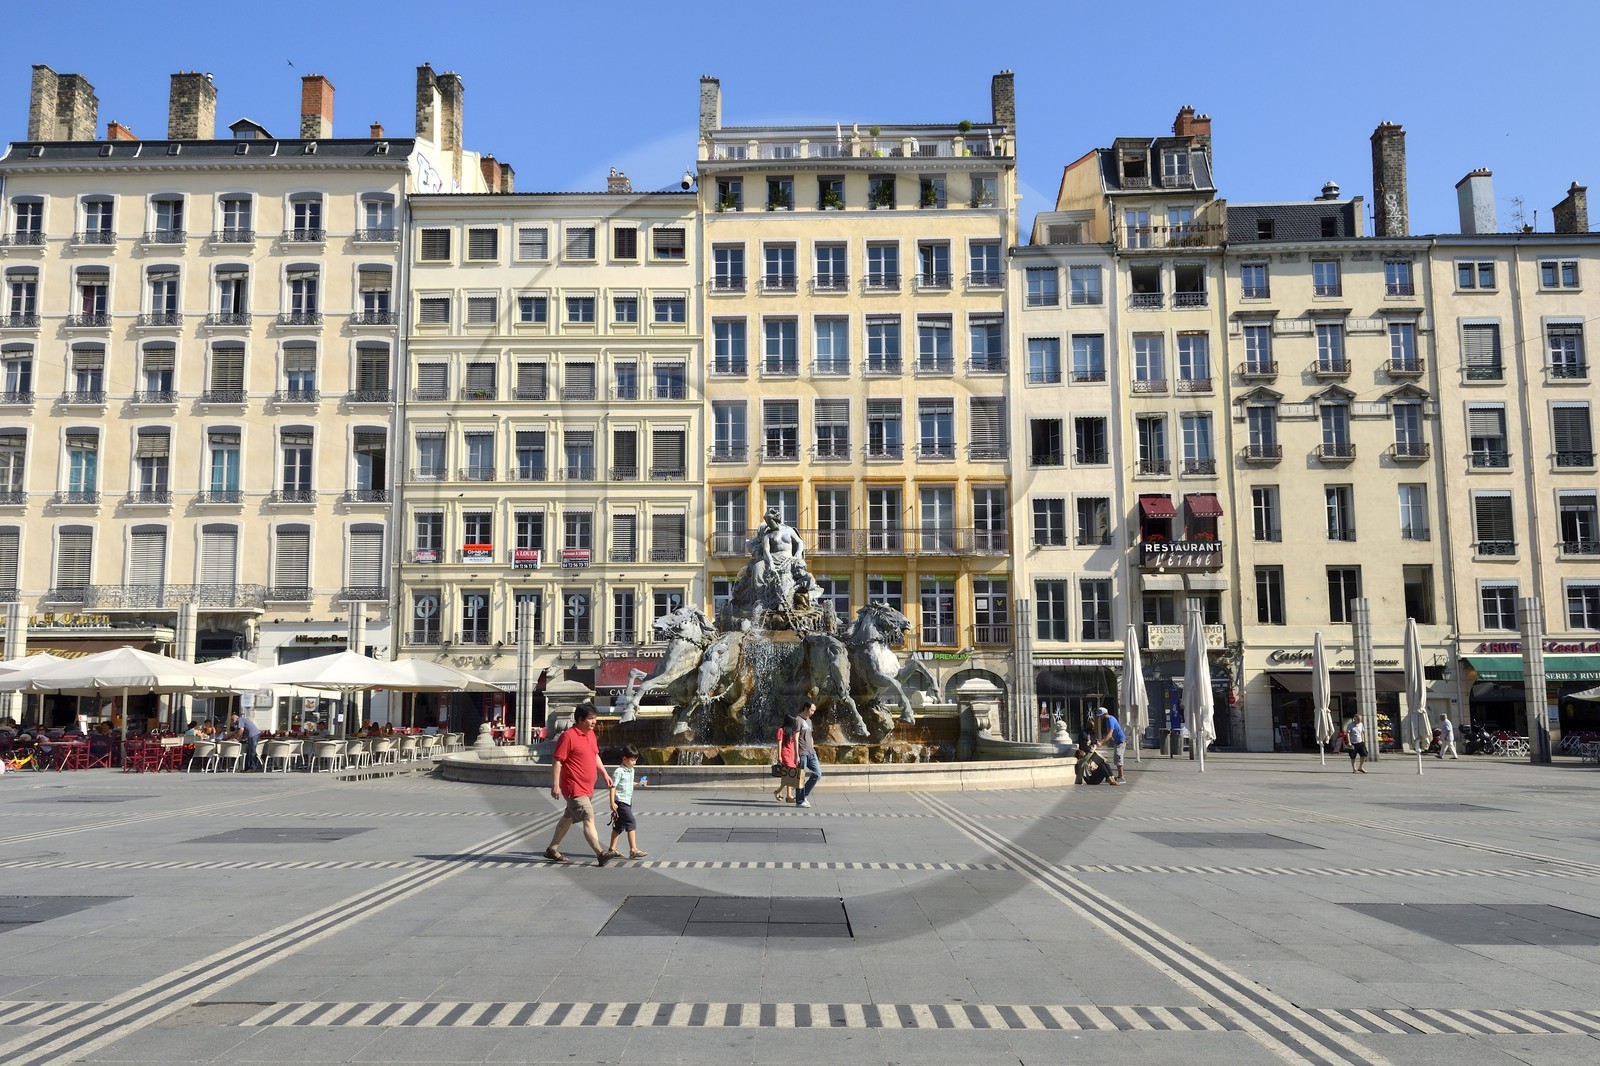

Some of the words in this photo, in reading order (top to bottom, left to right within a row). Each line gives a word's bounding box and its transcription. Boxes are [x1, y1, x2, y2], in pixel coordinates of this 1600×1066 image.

[1145, 543, 1221, 552] RESTAURANT
[295, 634, 348, 645] Häagen-Daz
[1480, 642, 1488, 654] 3
[1551, 642, 1579, 653] Casa
[613, 649, 628, 658] La
[636, 649, 666, 658] Font
[934, 652, 971, 660] PREMIUM
[1271, 649, 1314, 662] Casin
[1070, 658, 1099, 666] Fabricant
[1101, 658, 1123, 666] Glacier
[1545, 672, 1571, 680] SERIE
[1572, 672, 1578, 680] 3
